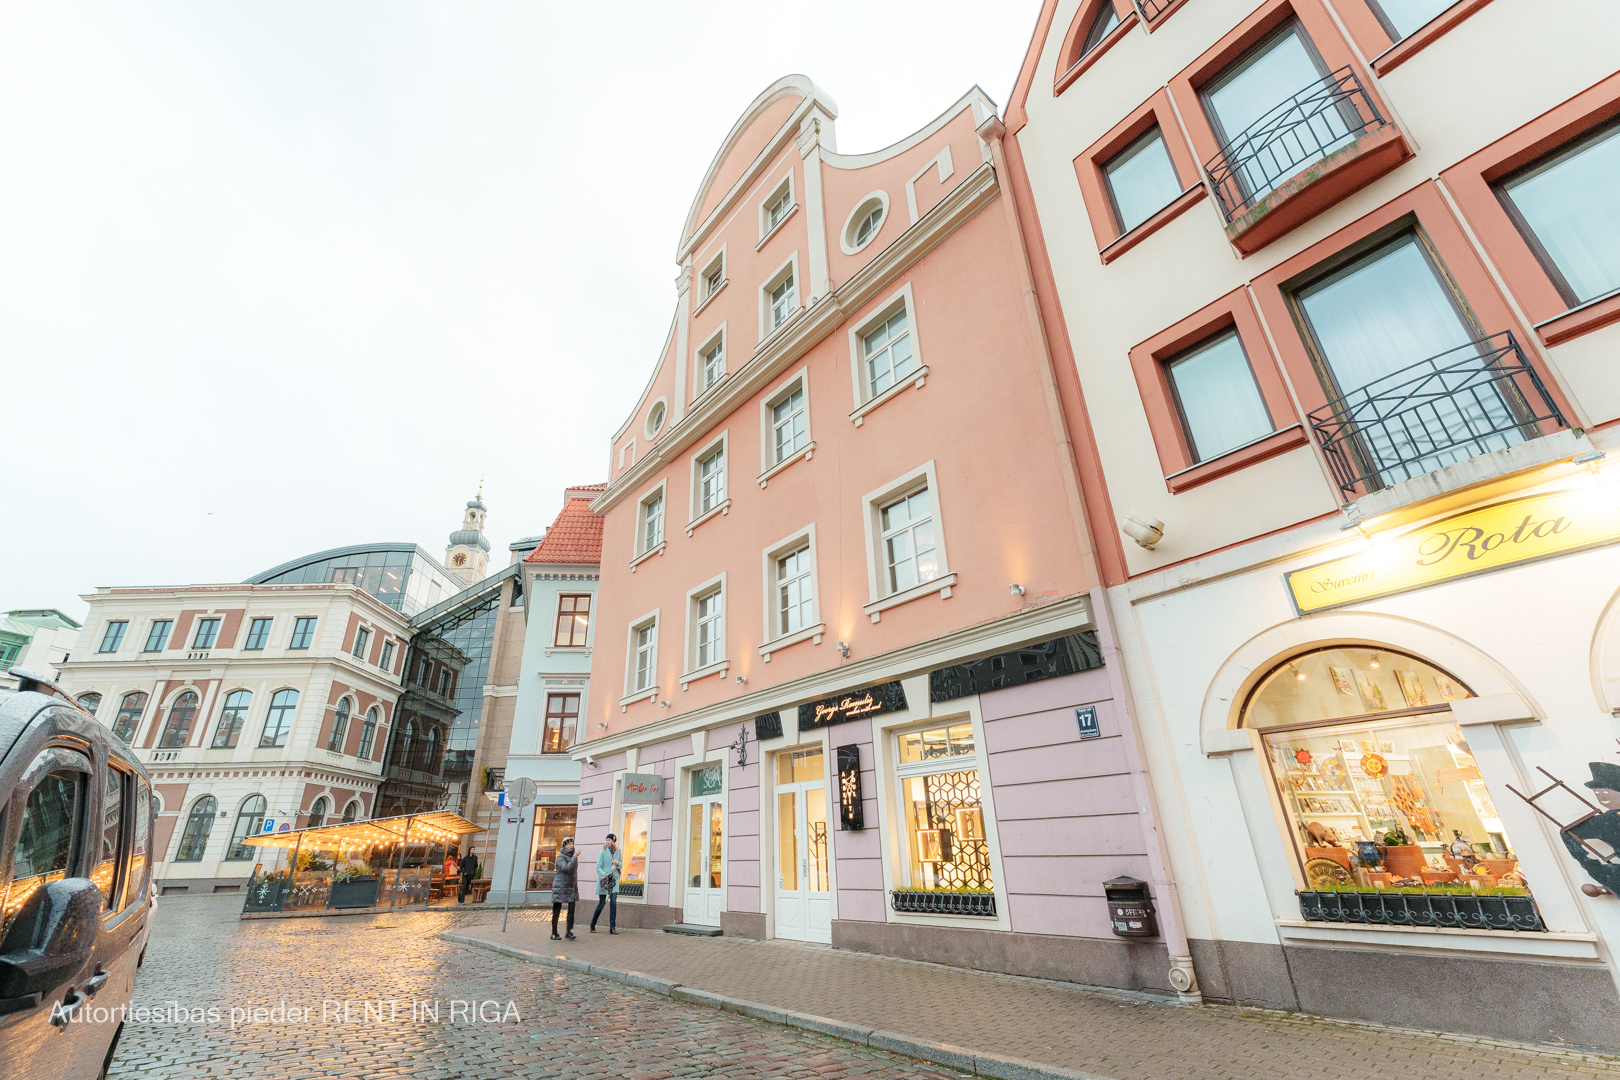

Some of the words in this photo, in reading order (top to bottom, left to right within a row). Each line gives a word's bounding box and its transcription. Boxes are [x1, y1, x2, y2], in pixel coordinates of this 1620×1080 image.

[1310, 568, 1375, 593] Suvenīri
[1416, 515, 1572, 566] Rota
[814, 705, 839, 722] Georgs
[1079, 714, 1092, 727] 17
[626, 781, 648, 794] Amber
[265, 820, 273, 831] P
